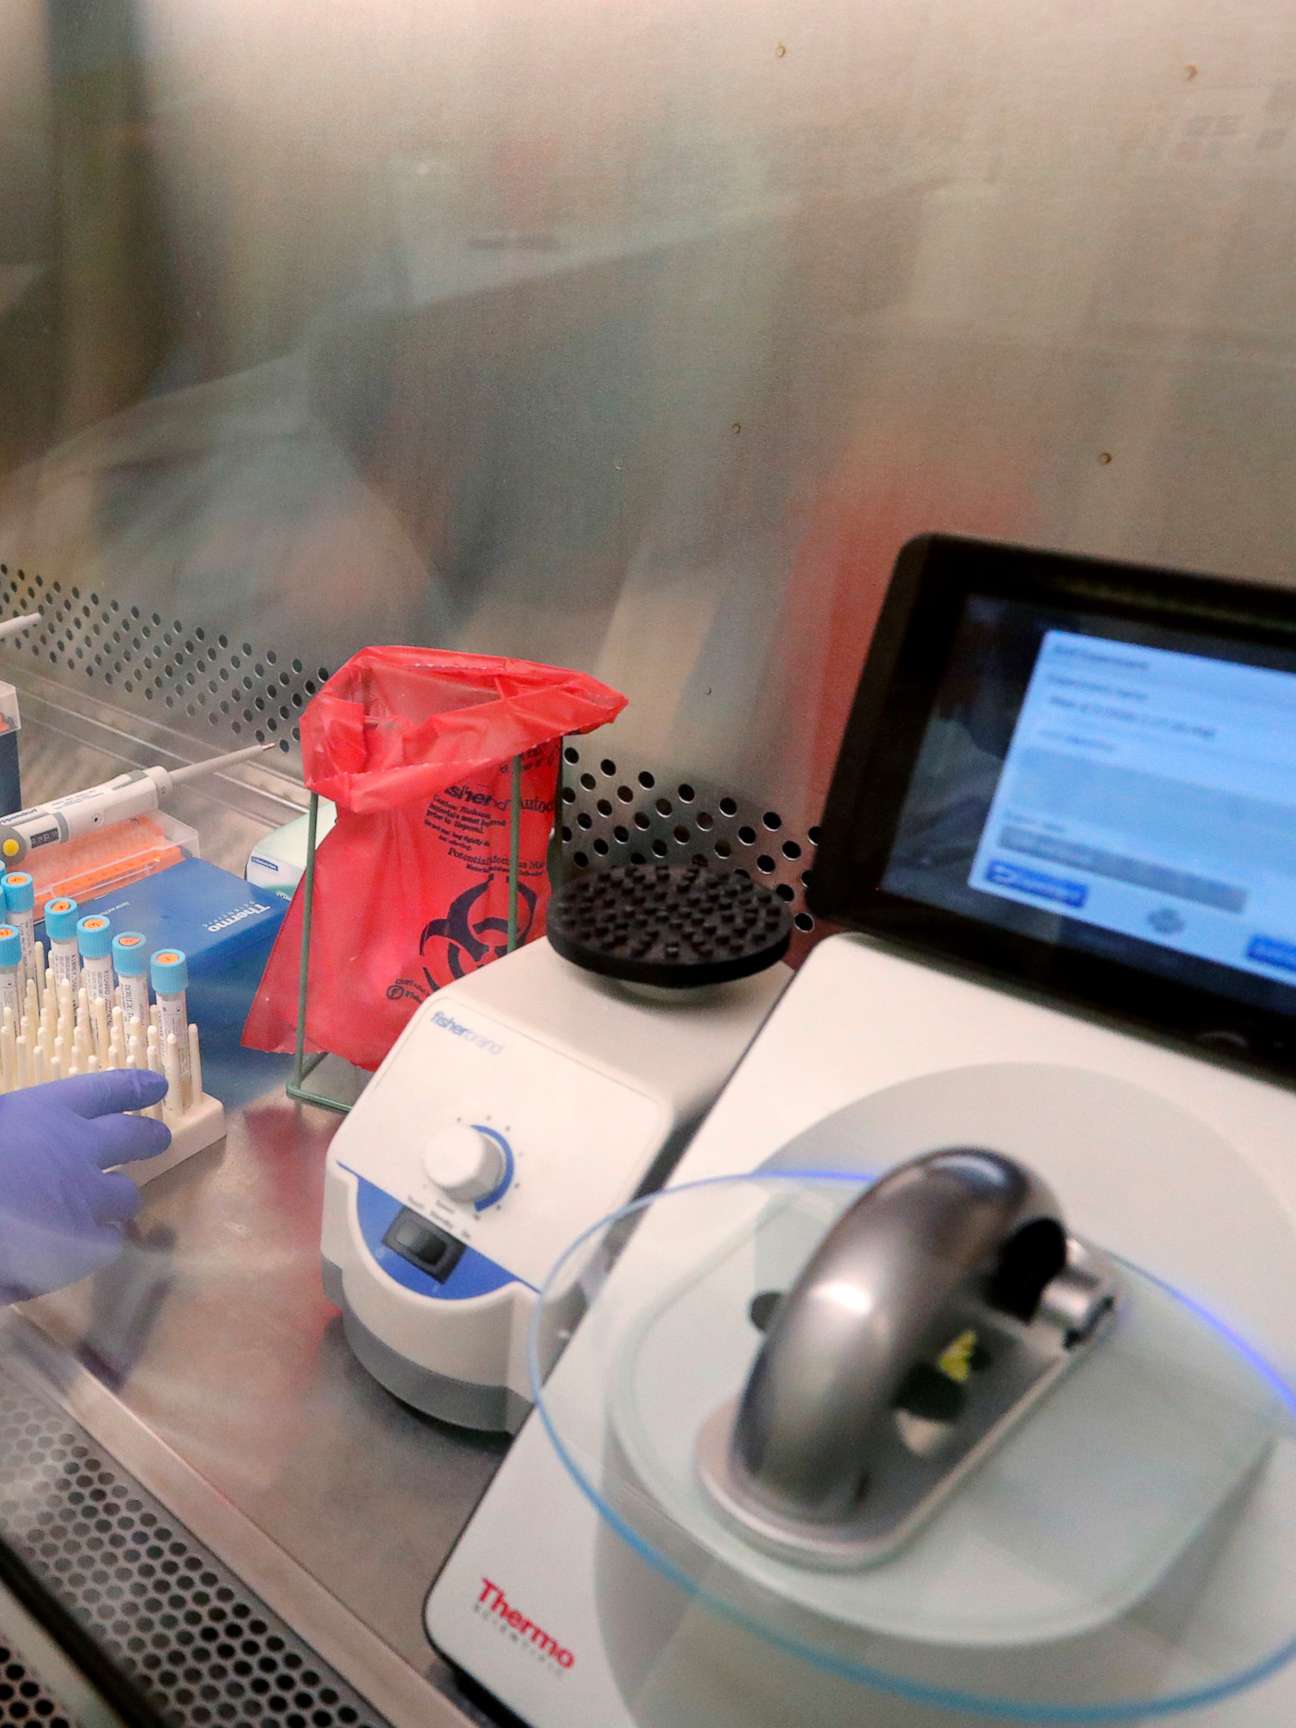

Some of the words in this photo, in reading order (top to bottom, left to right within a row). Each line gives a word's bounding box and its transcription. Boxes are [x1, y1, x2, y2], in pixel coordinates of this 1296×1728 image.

[207, 902, 271, 932] Thermo
[431, 1011, 503, 1055] fisherbrand
[479, 1578, 575, 1669] Thermo
